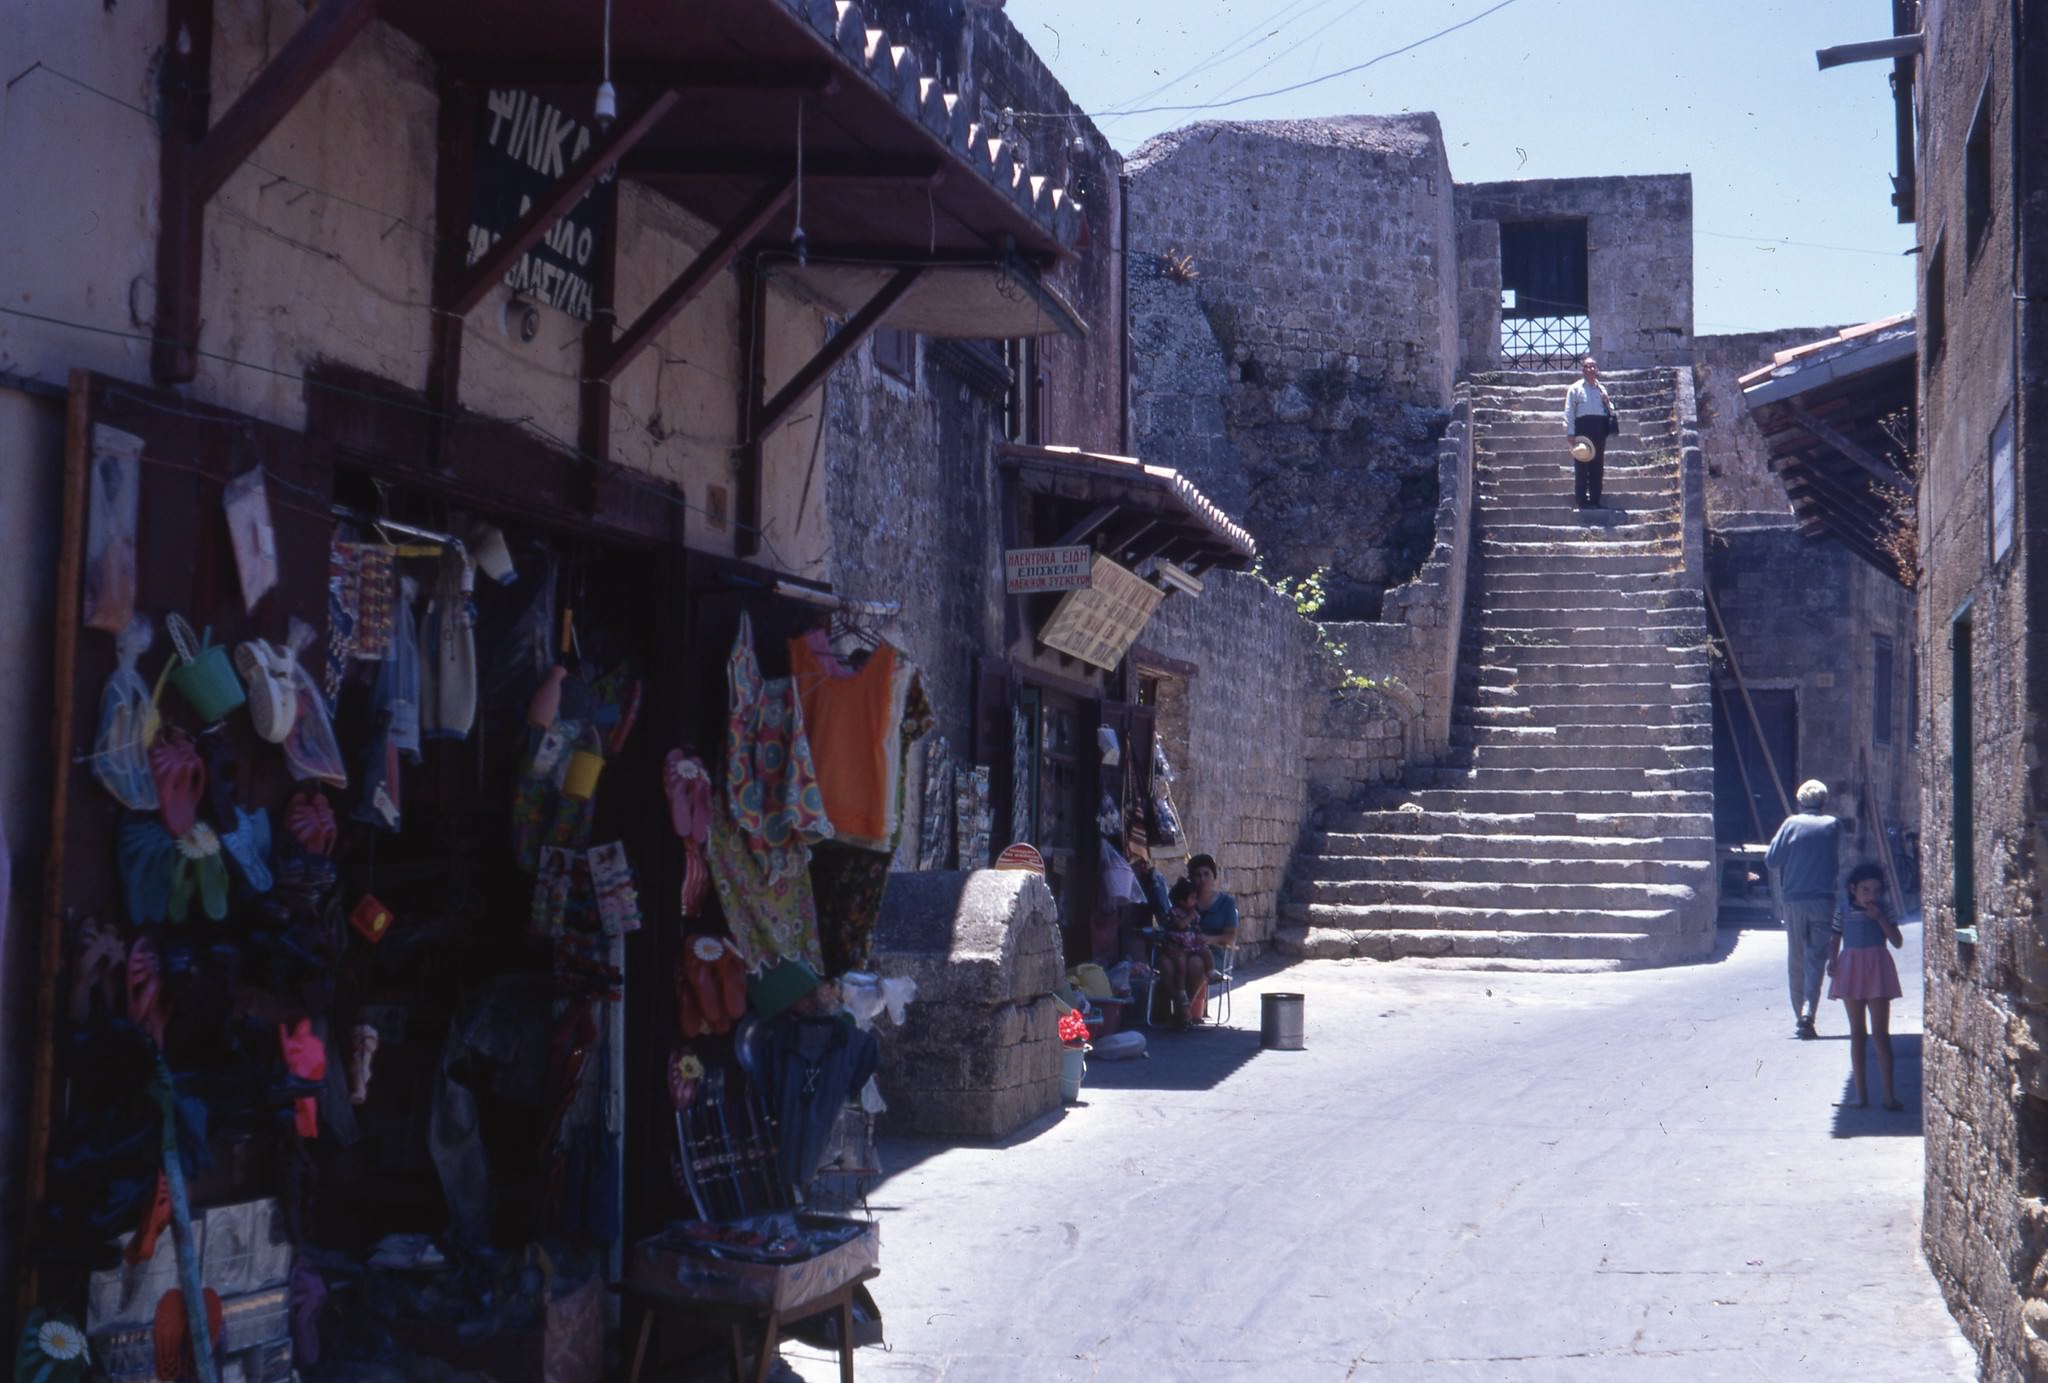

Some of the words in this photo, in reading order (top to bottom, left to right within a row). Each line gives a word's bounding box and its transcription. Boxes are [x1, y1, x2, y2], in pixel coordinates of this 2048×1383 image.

[1008, 551, 1056, 566] ΗΛΕΚΤΡΙΚΑ
[1062, 549, 1088, 563] ΕΙΔΗ
[1018, 564, 1078, 578] ΕΠΙΣΚΕΥΑΙ
